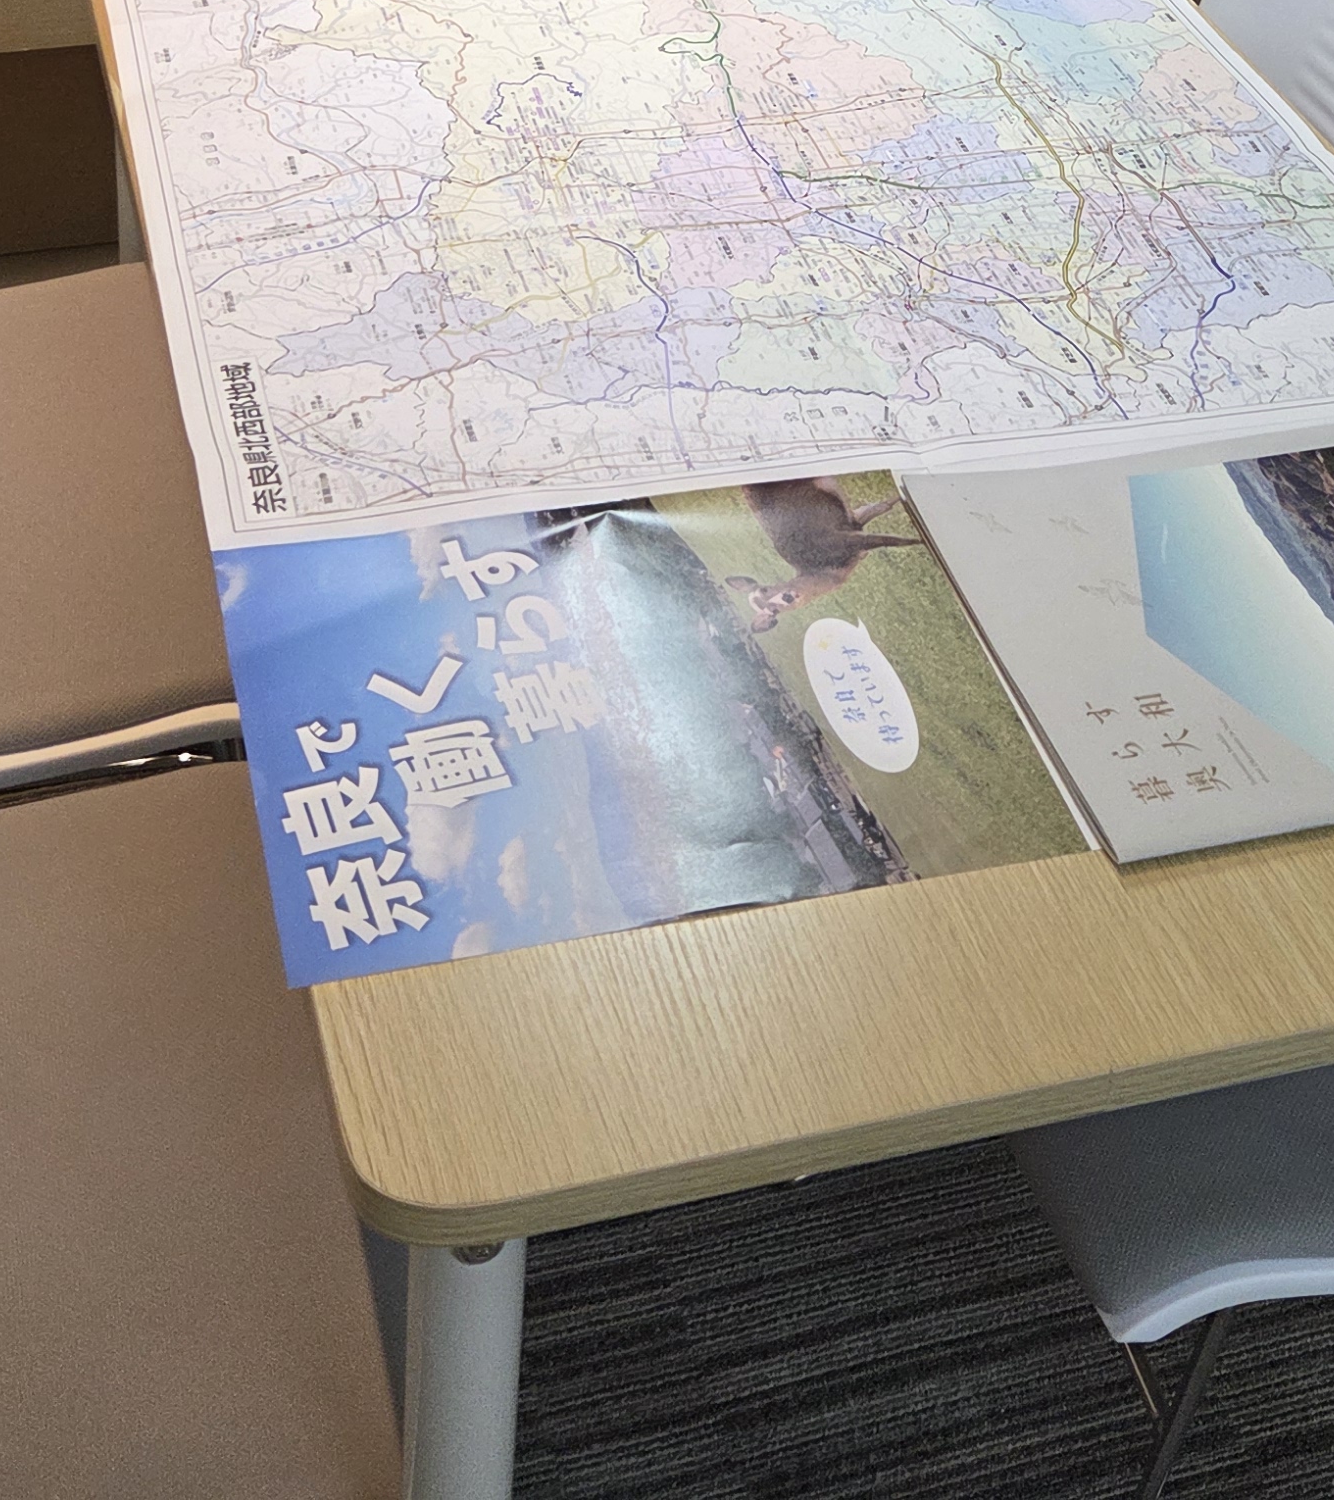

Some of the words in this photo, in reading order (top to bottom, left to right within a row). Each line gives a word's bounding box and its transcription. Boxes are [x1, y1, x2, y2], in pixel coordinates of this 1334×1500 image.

[220, 362, 287, 514] 奈良県北西部地域
[440, 539, 606, 745] 暮らす
[366, 652, 512, 808] 働く
[1085, 701, 1174, 804] 暮らす
[1134, 693, 1232, 792] 奥大和
[281, 721, 429, 951] 奈良で
